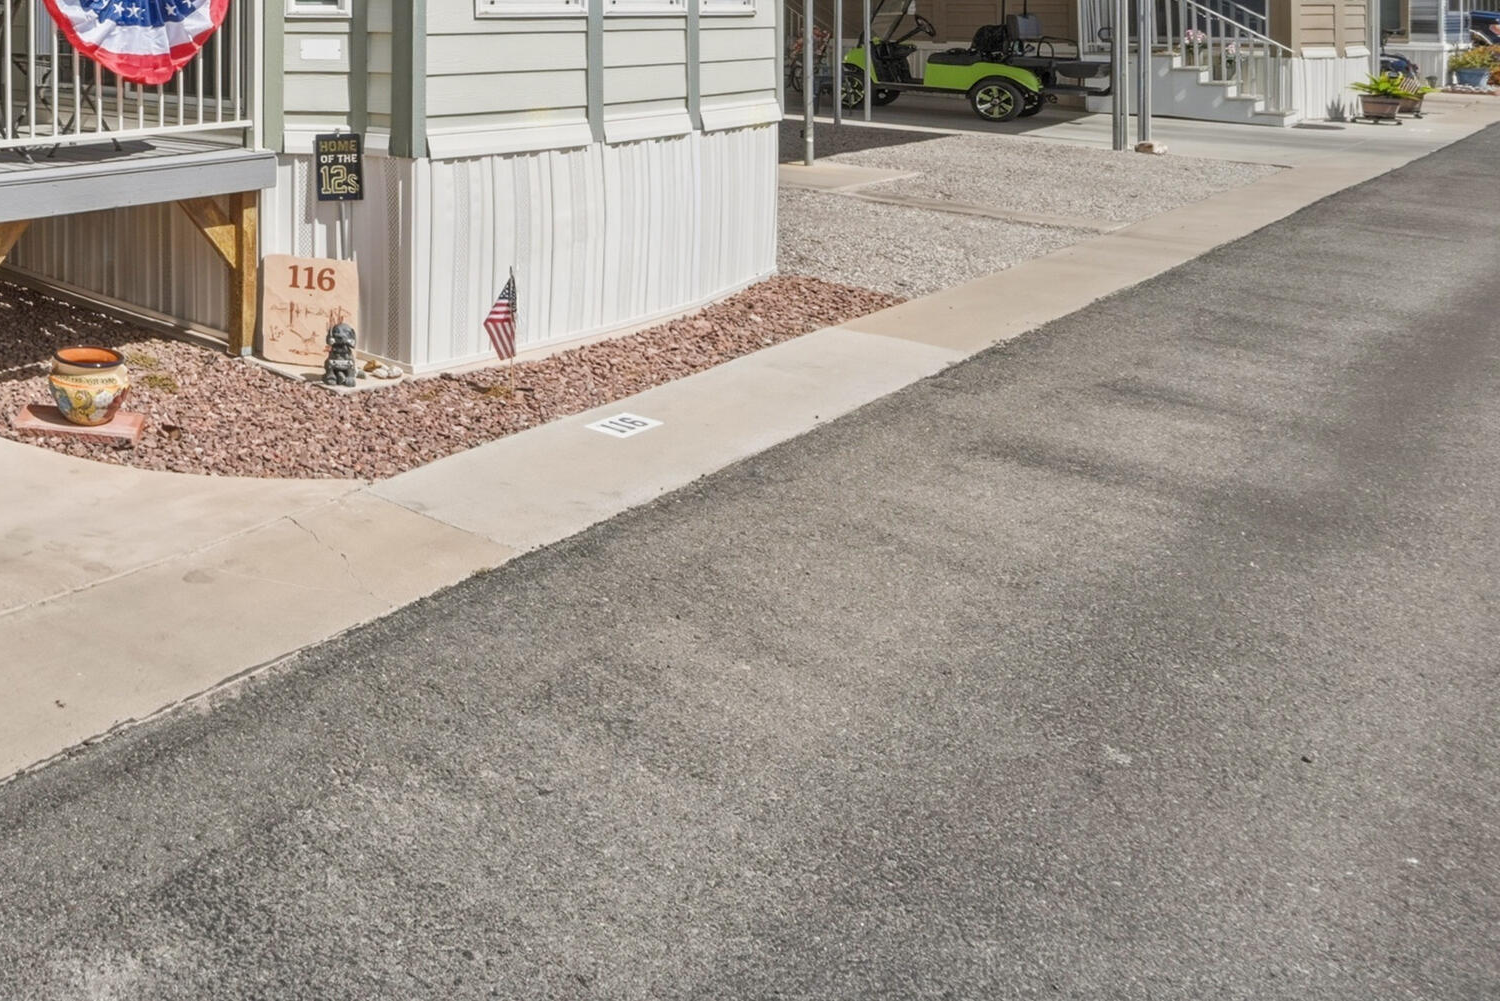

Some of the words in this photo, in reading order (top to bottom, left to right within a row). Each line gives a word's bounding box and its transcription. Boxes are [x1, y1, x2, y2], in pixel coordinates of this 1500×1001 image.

[319, 140, 357, 152] HOME
[320, 154, 335, 164] OF
[337, 153, 358, 163] THE
[288, 264, 336, 291] 116
[600, 416, 649, 434] 116
